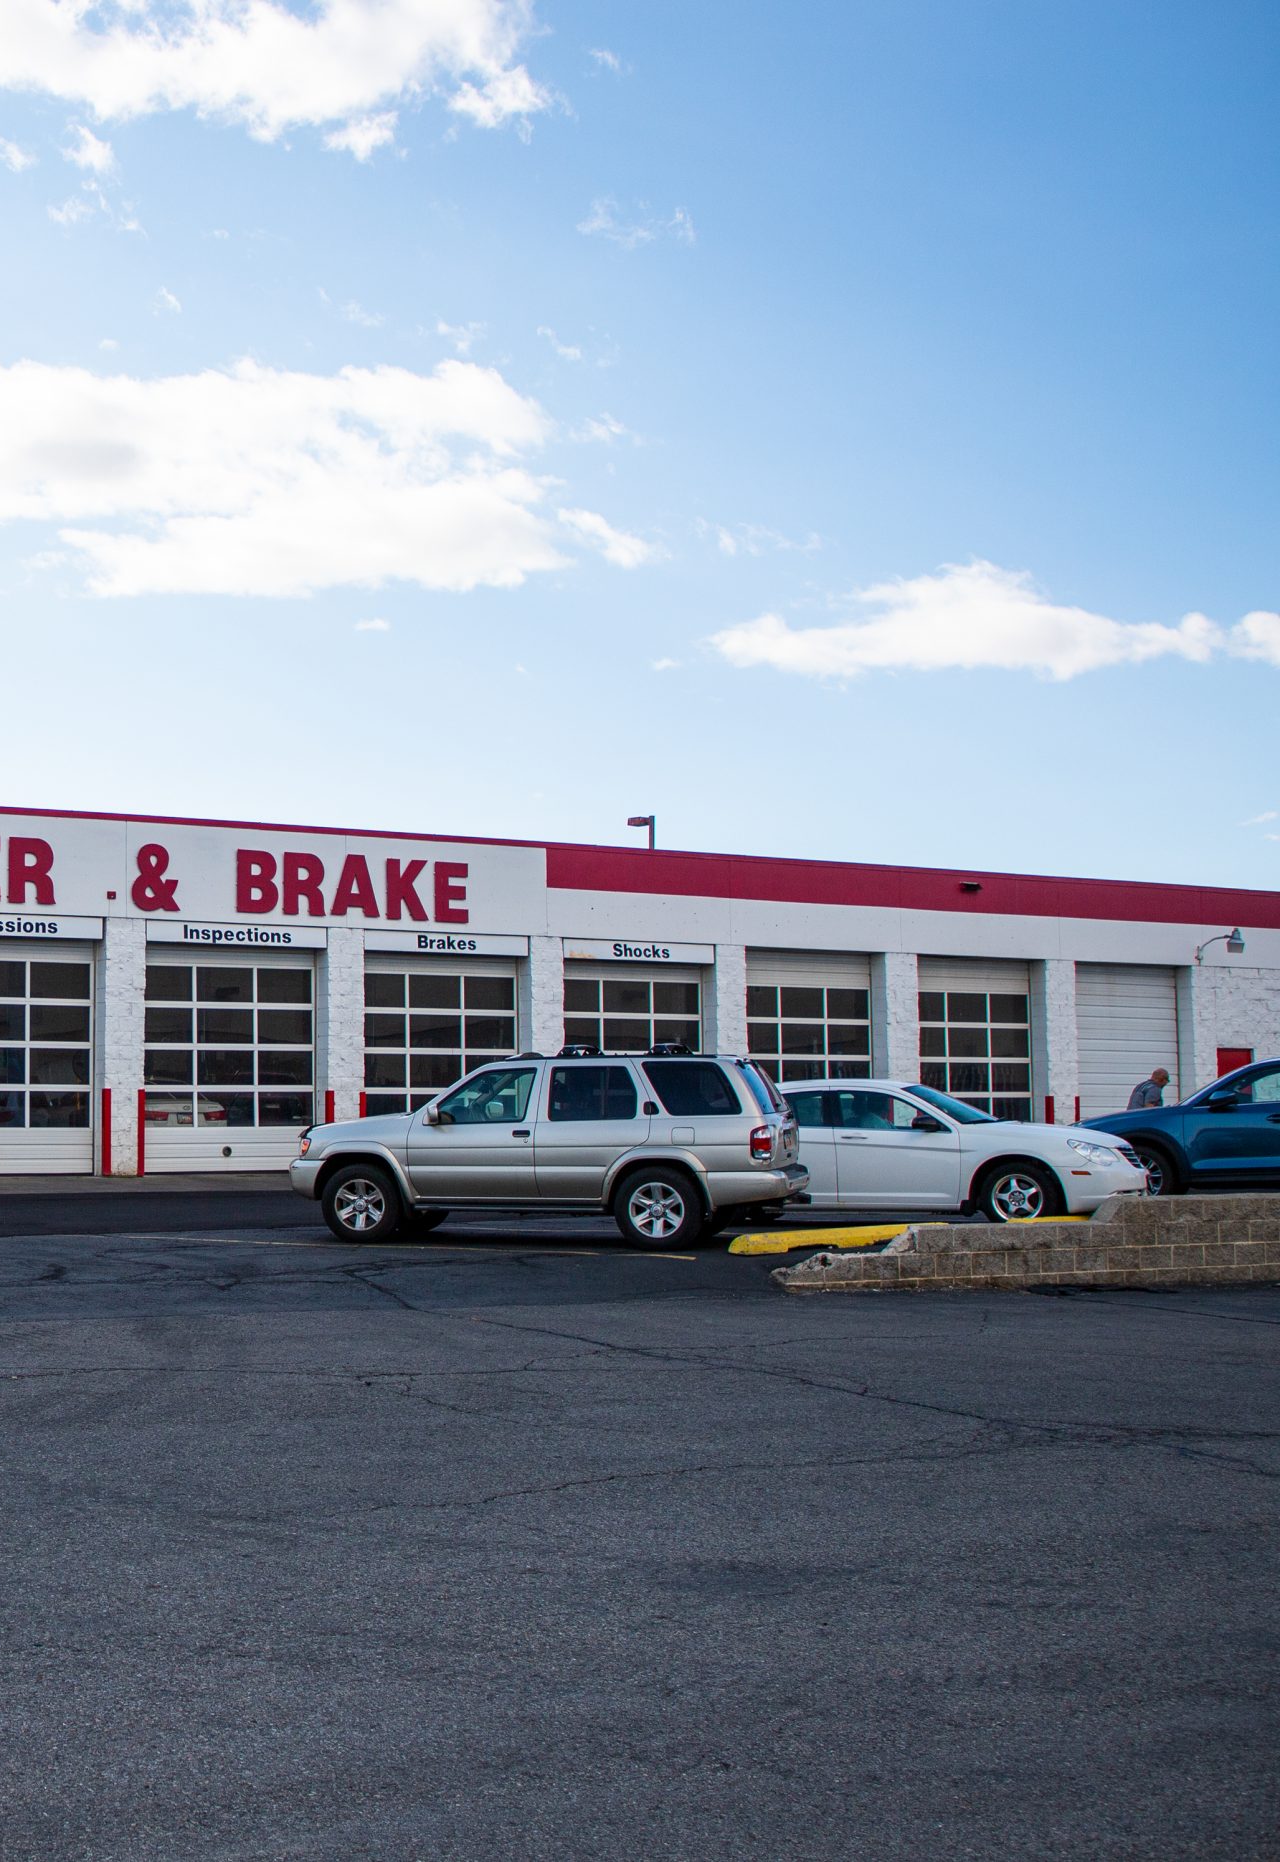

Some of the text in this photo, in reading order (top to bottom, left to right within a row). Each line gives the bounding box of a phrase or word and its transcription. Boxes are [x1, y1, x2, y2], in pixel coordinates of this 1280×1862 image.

[131, 843, 181, 912] &
[236, 848, 469, 924] BRAKE
[183, 924, 292, 945] Inspections
[417, 935, 477, 951] Brakes
[612, 943, 670, 959] Shocks
